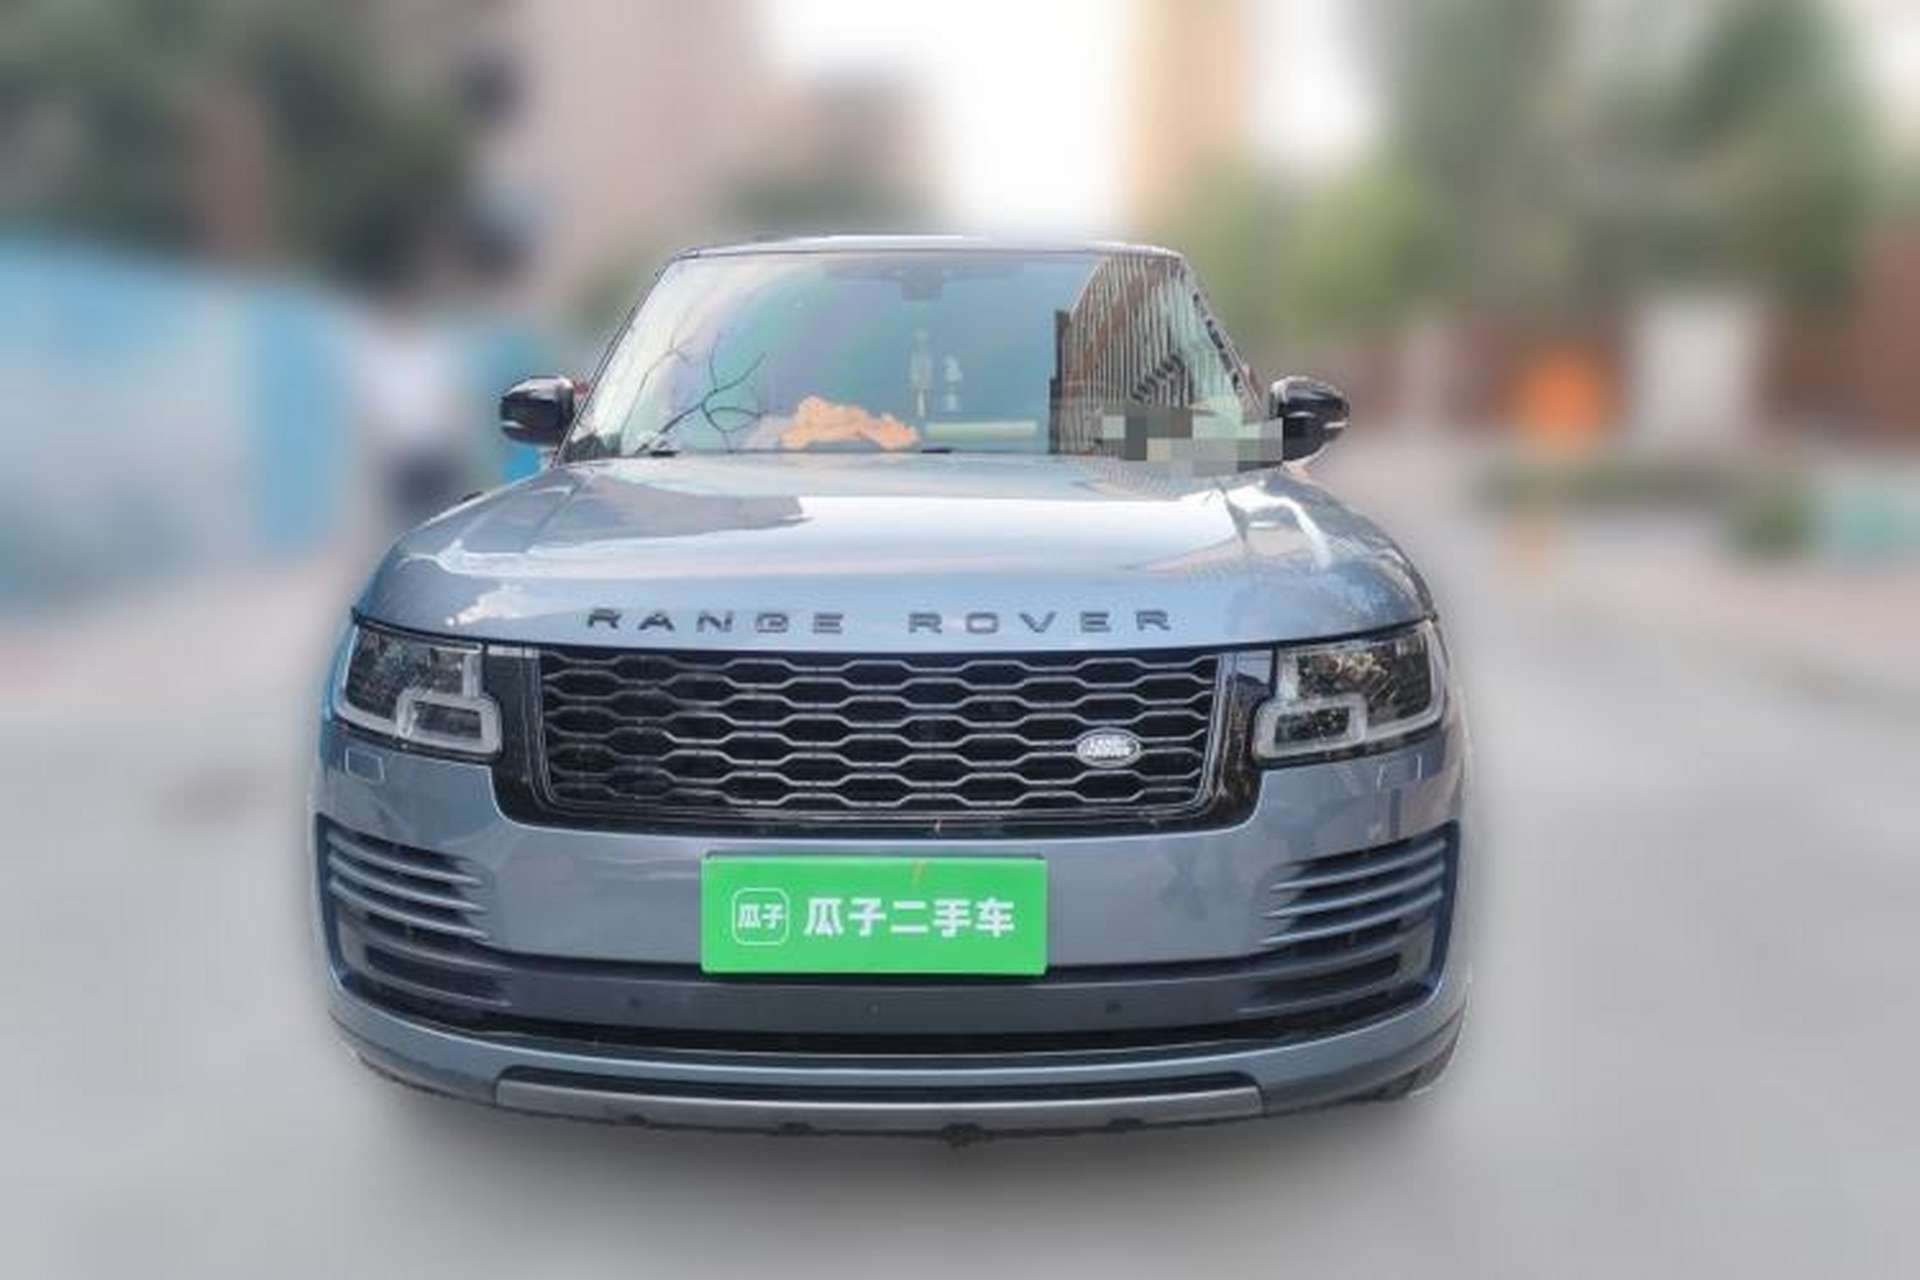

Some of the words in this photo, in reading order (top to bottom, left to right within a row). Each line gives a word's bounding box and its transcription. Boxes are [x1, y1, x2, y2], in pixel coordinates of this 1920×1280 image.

[586, 608, 844, 634] RANGE
[908, 610, 1171, 635] ROVER
[737, 903, 785, 929] 瓜子
[803, 897, 1015, 938] 瓜子二手车
